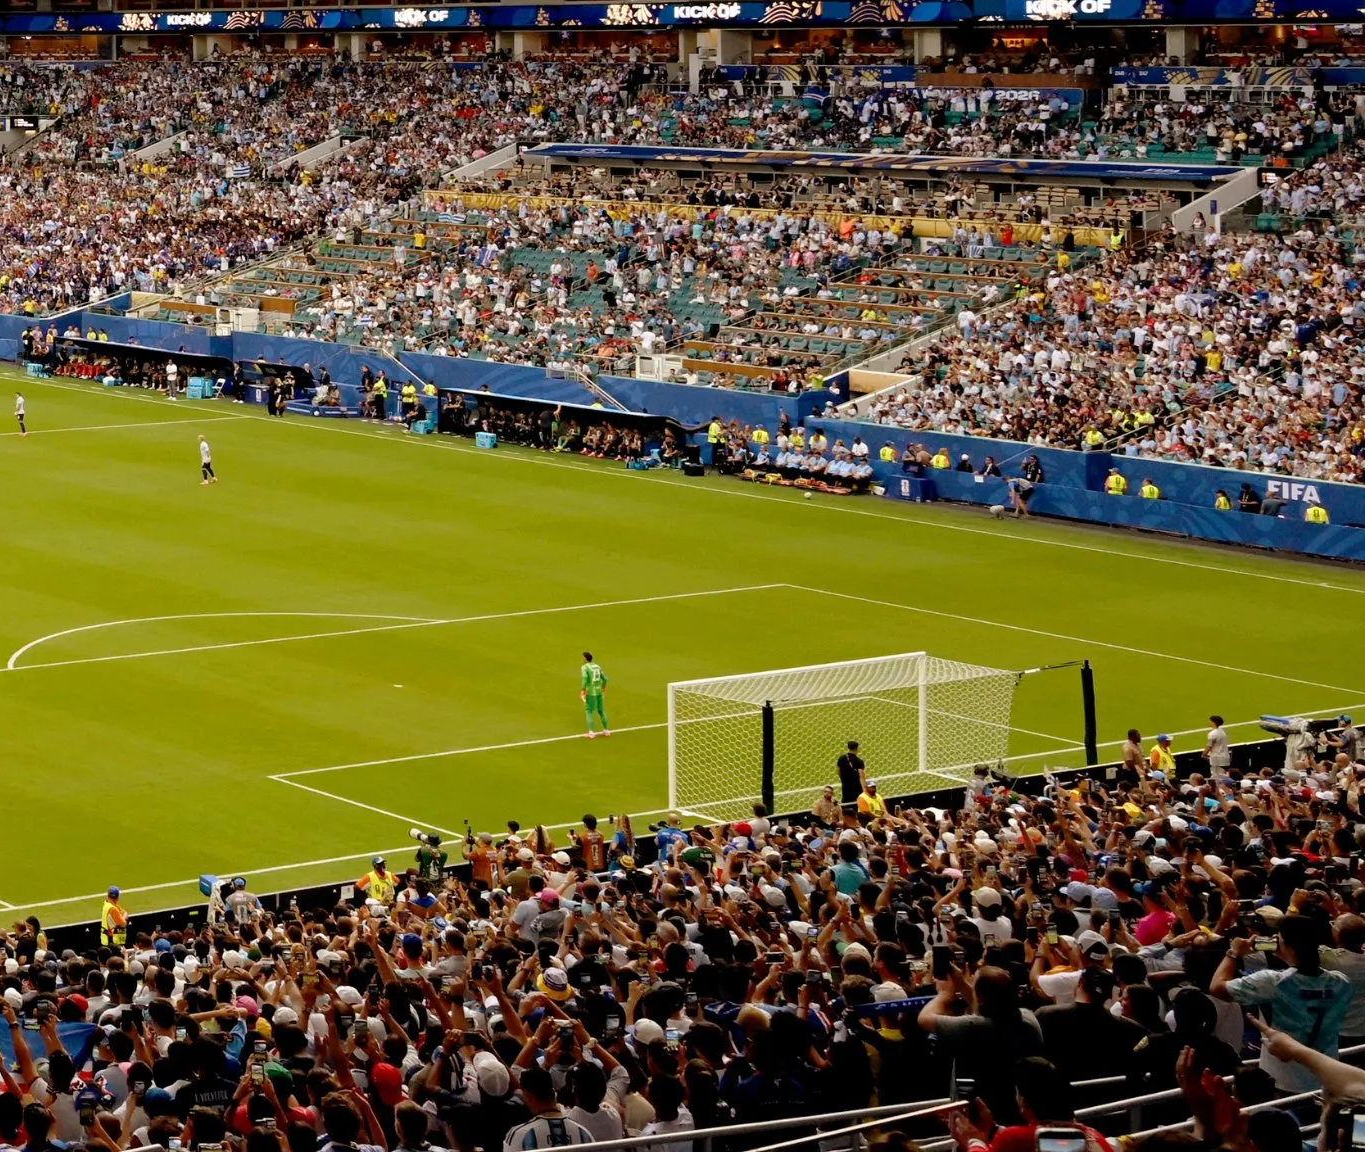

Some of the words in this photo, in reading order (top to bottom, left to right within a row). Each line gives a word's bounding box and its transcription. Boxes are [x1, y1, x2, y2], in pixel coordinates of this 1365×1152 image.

[674, 6, 715, 19] KICK
[1026, 0, 1077, 14] KICK
[1080, 0, 1112, 14] OF
[167, 14, 195, 25] KICK
[394, 11, 427, 22] KICK
[429, 10, 449, 21] OF
[1267, 479, 1321, 504] FIFA
